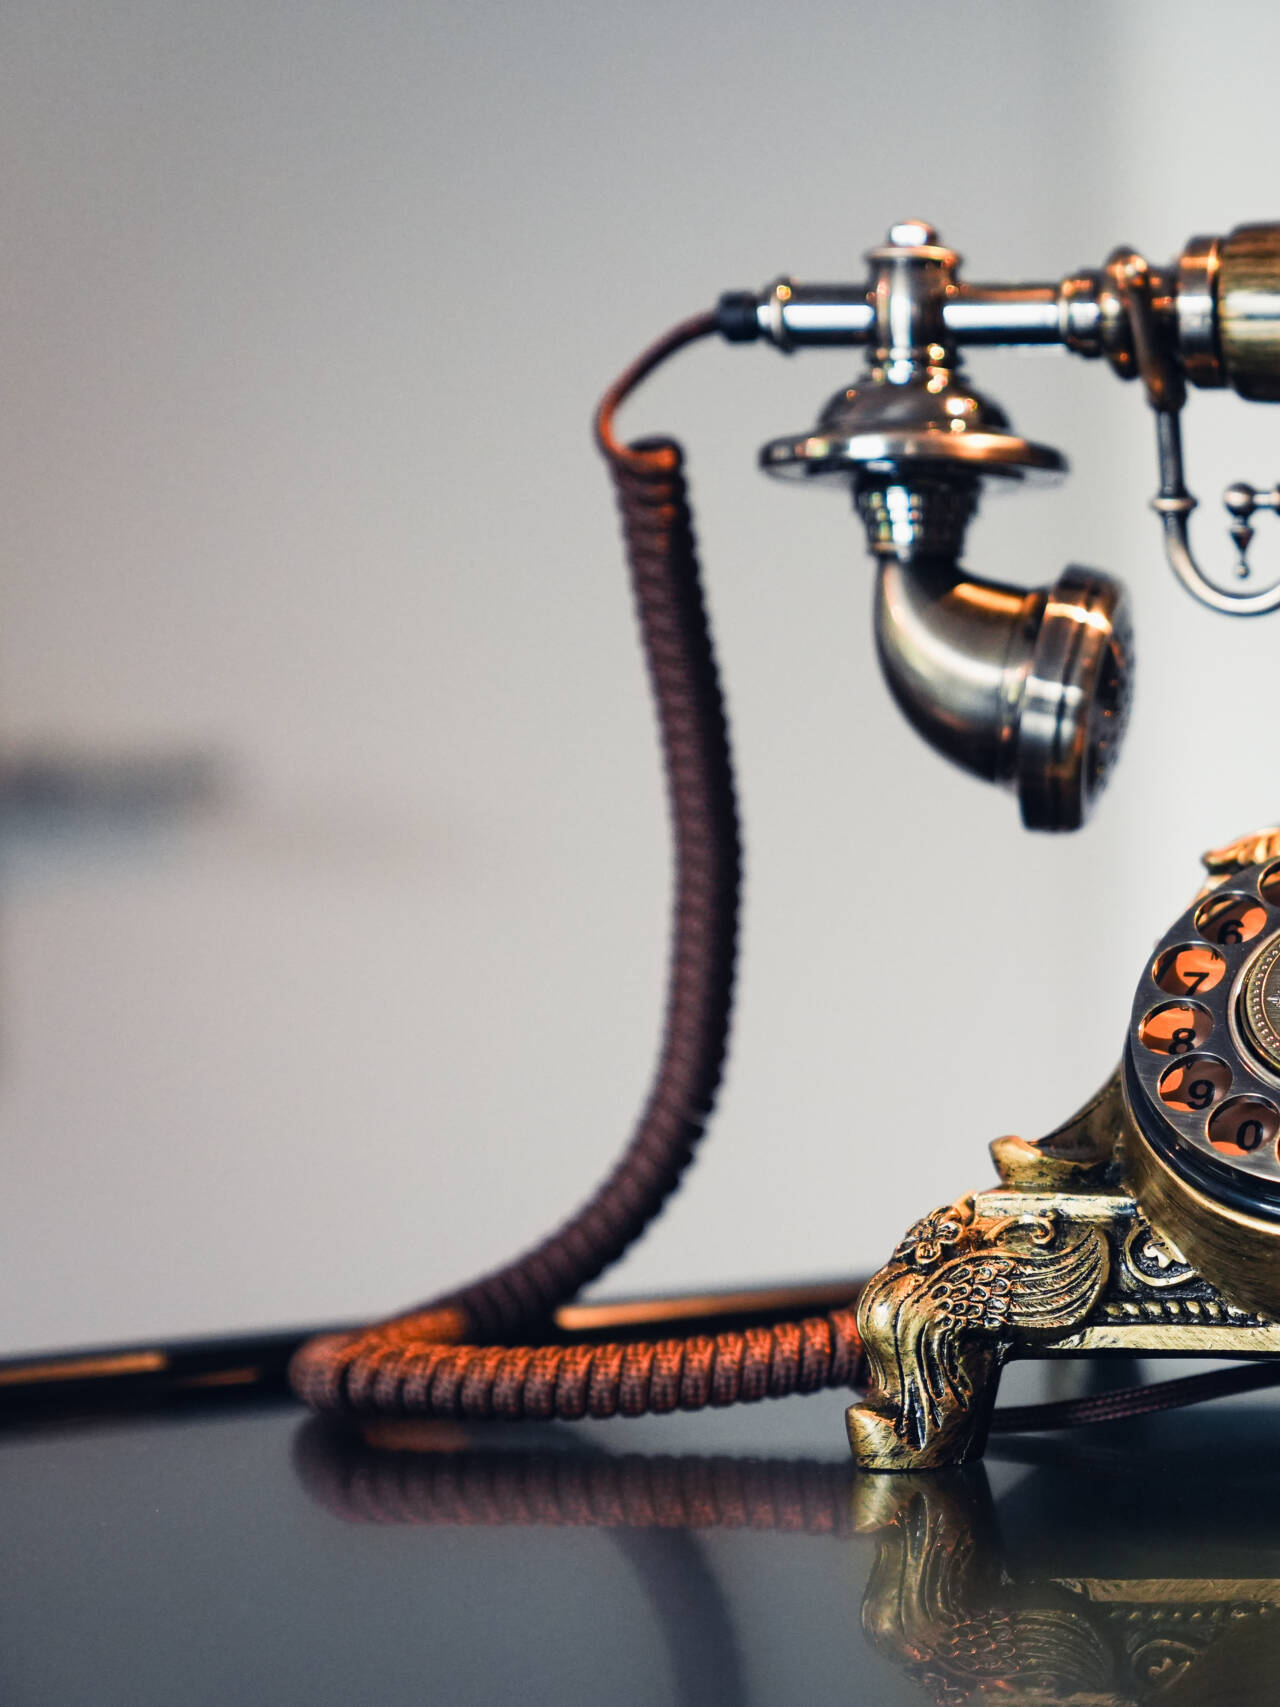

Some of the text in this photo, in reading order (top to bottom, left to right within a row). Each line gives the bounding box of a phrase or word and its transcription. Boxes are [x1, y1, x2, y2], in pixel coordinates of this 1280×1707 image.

[1217, 919, 1244, 945] 6
[1183, 971, 1210, 997] 7
[1168, 1027, 1197, 1056] 8
[1187, 1079, 1216, 1110] 9
[1236, 1119, 1264, 1151] 0
